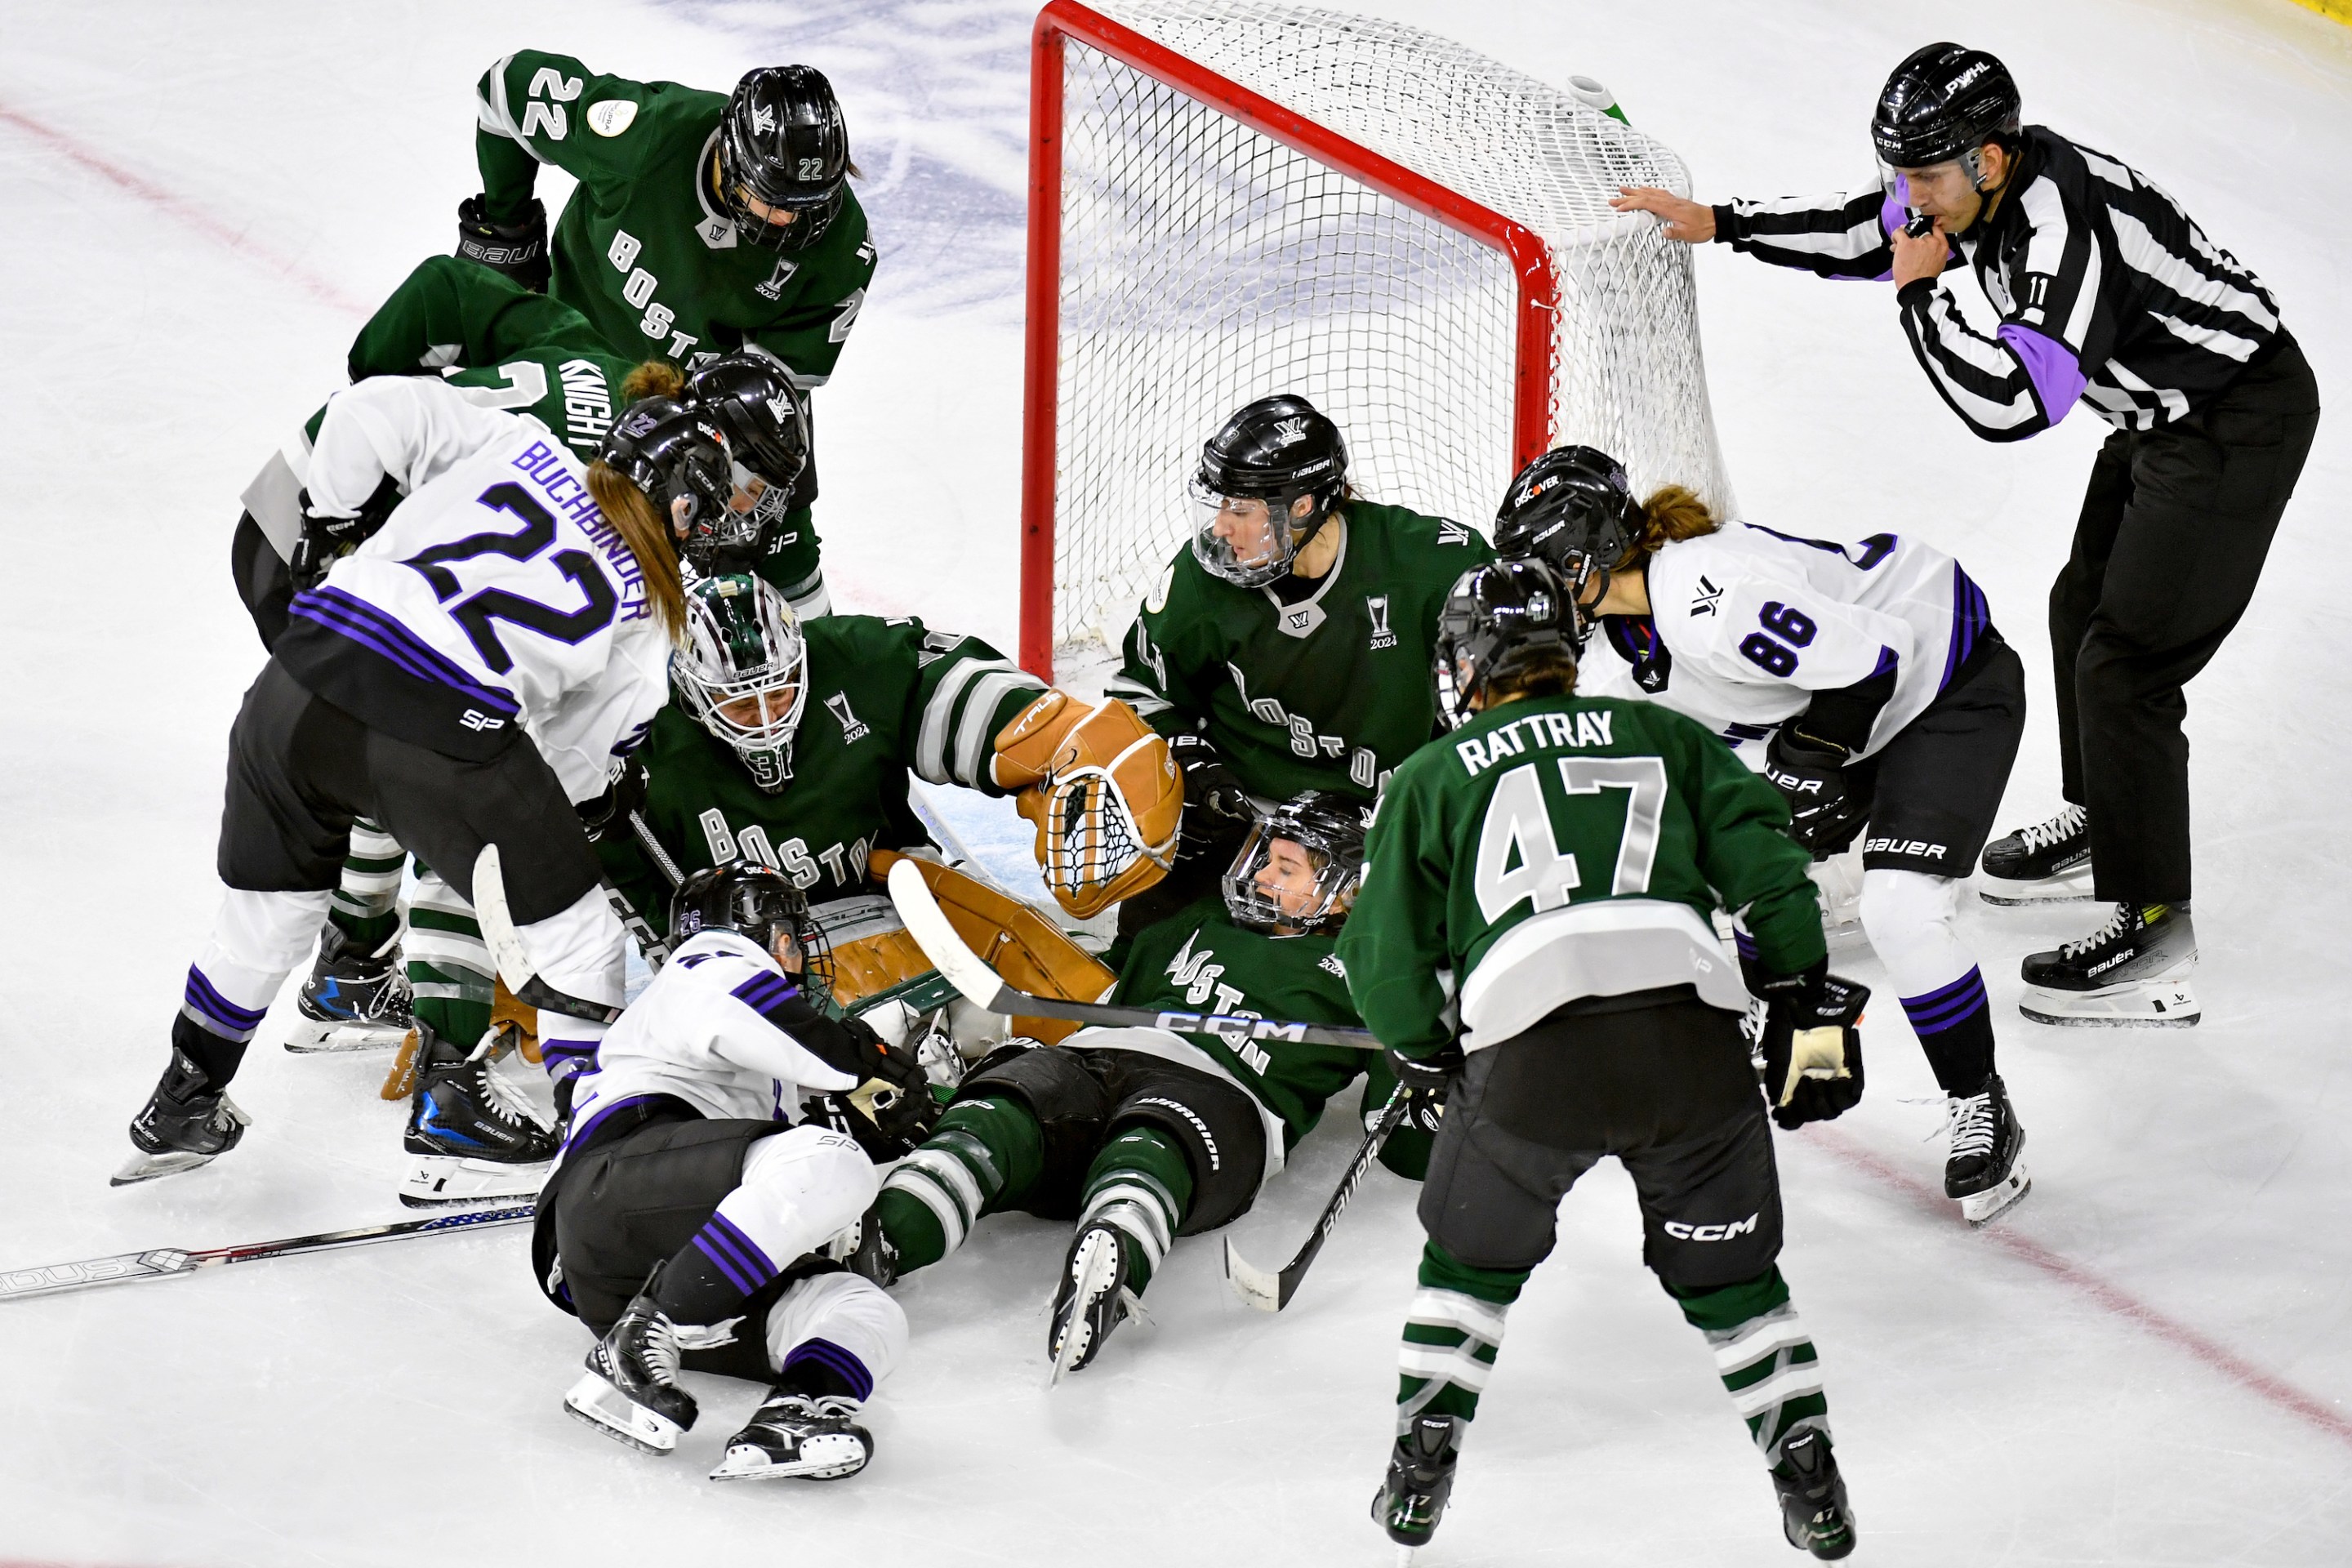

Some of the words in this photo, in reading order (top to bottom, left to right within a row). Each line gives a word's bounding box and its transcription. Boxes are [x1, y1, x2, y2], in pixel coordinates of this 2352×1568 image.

[522, 67, 584, 140] 22
[1876, 136, 1901, 150] CCM
[798, 158, 822, 181] 22
[755, 283, 782, 301] 2024
[2029, 276, 2048, 305] 11
[622, 412, 659, 439] 22
[695, 468, 716, 491] CCM
[1515, 475, 1561, 509] DISCOVER
[511, 440, 652, 623] BUCHBINDER
[394, 480, 619, 676] 22
[1370, 635, 1398, 650] 2024
[1739, 600, 1818, 678] 86
[1013, 690, 1062, 737] TRUE
[844, 724, 871, 746] 2024
[1455, 710, 1614, 777] RATTRAY
[747, 738, 795, 788] 31
[698, 807, 879, 890] BOSTO
[1474, 755, 1668, 926] 47
[680, 909, 702, 937] 26
[1317, 957, 1344, 978] 2024
[1155, 1011, 1307, 1043] CCM
[1134, 1097, 1220, 1171] WARRIOR
[1664, 1212, 1760, 1241] CCM
[1421, 1419, 1450, 1428] CCM
[1788, 1432, 1815, 1450] CCM
[1811, 1507, 1836, 1524] 47
